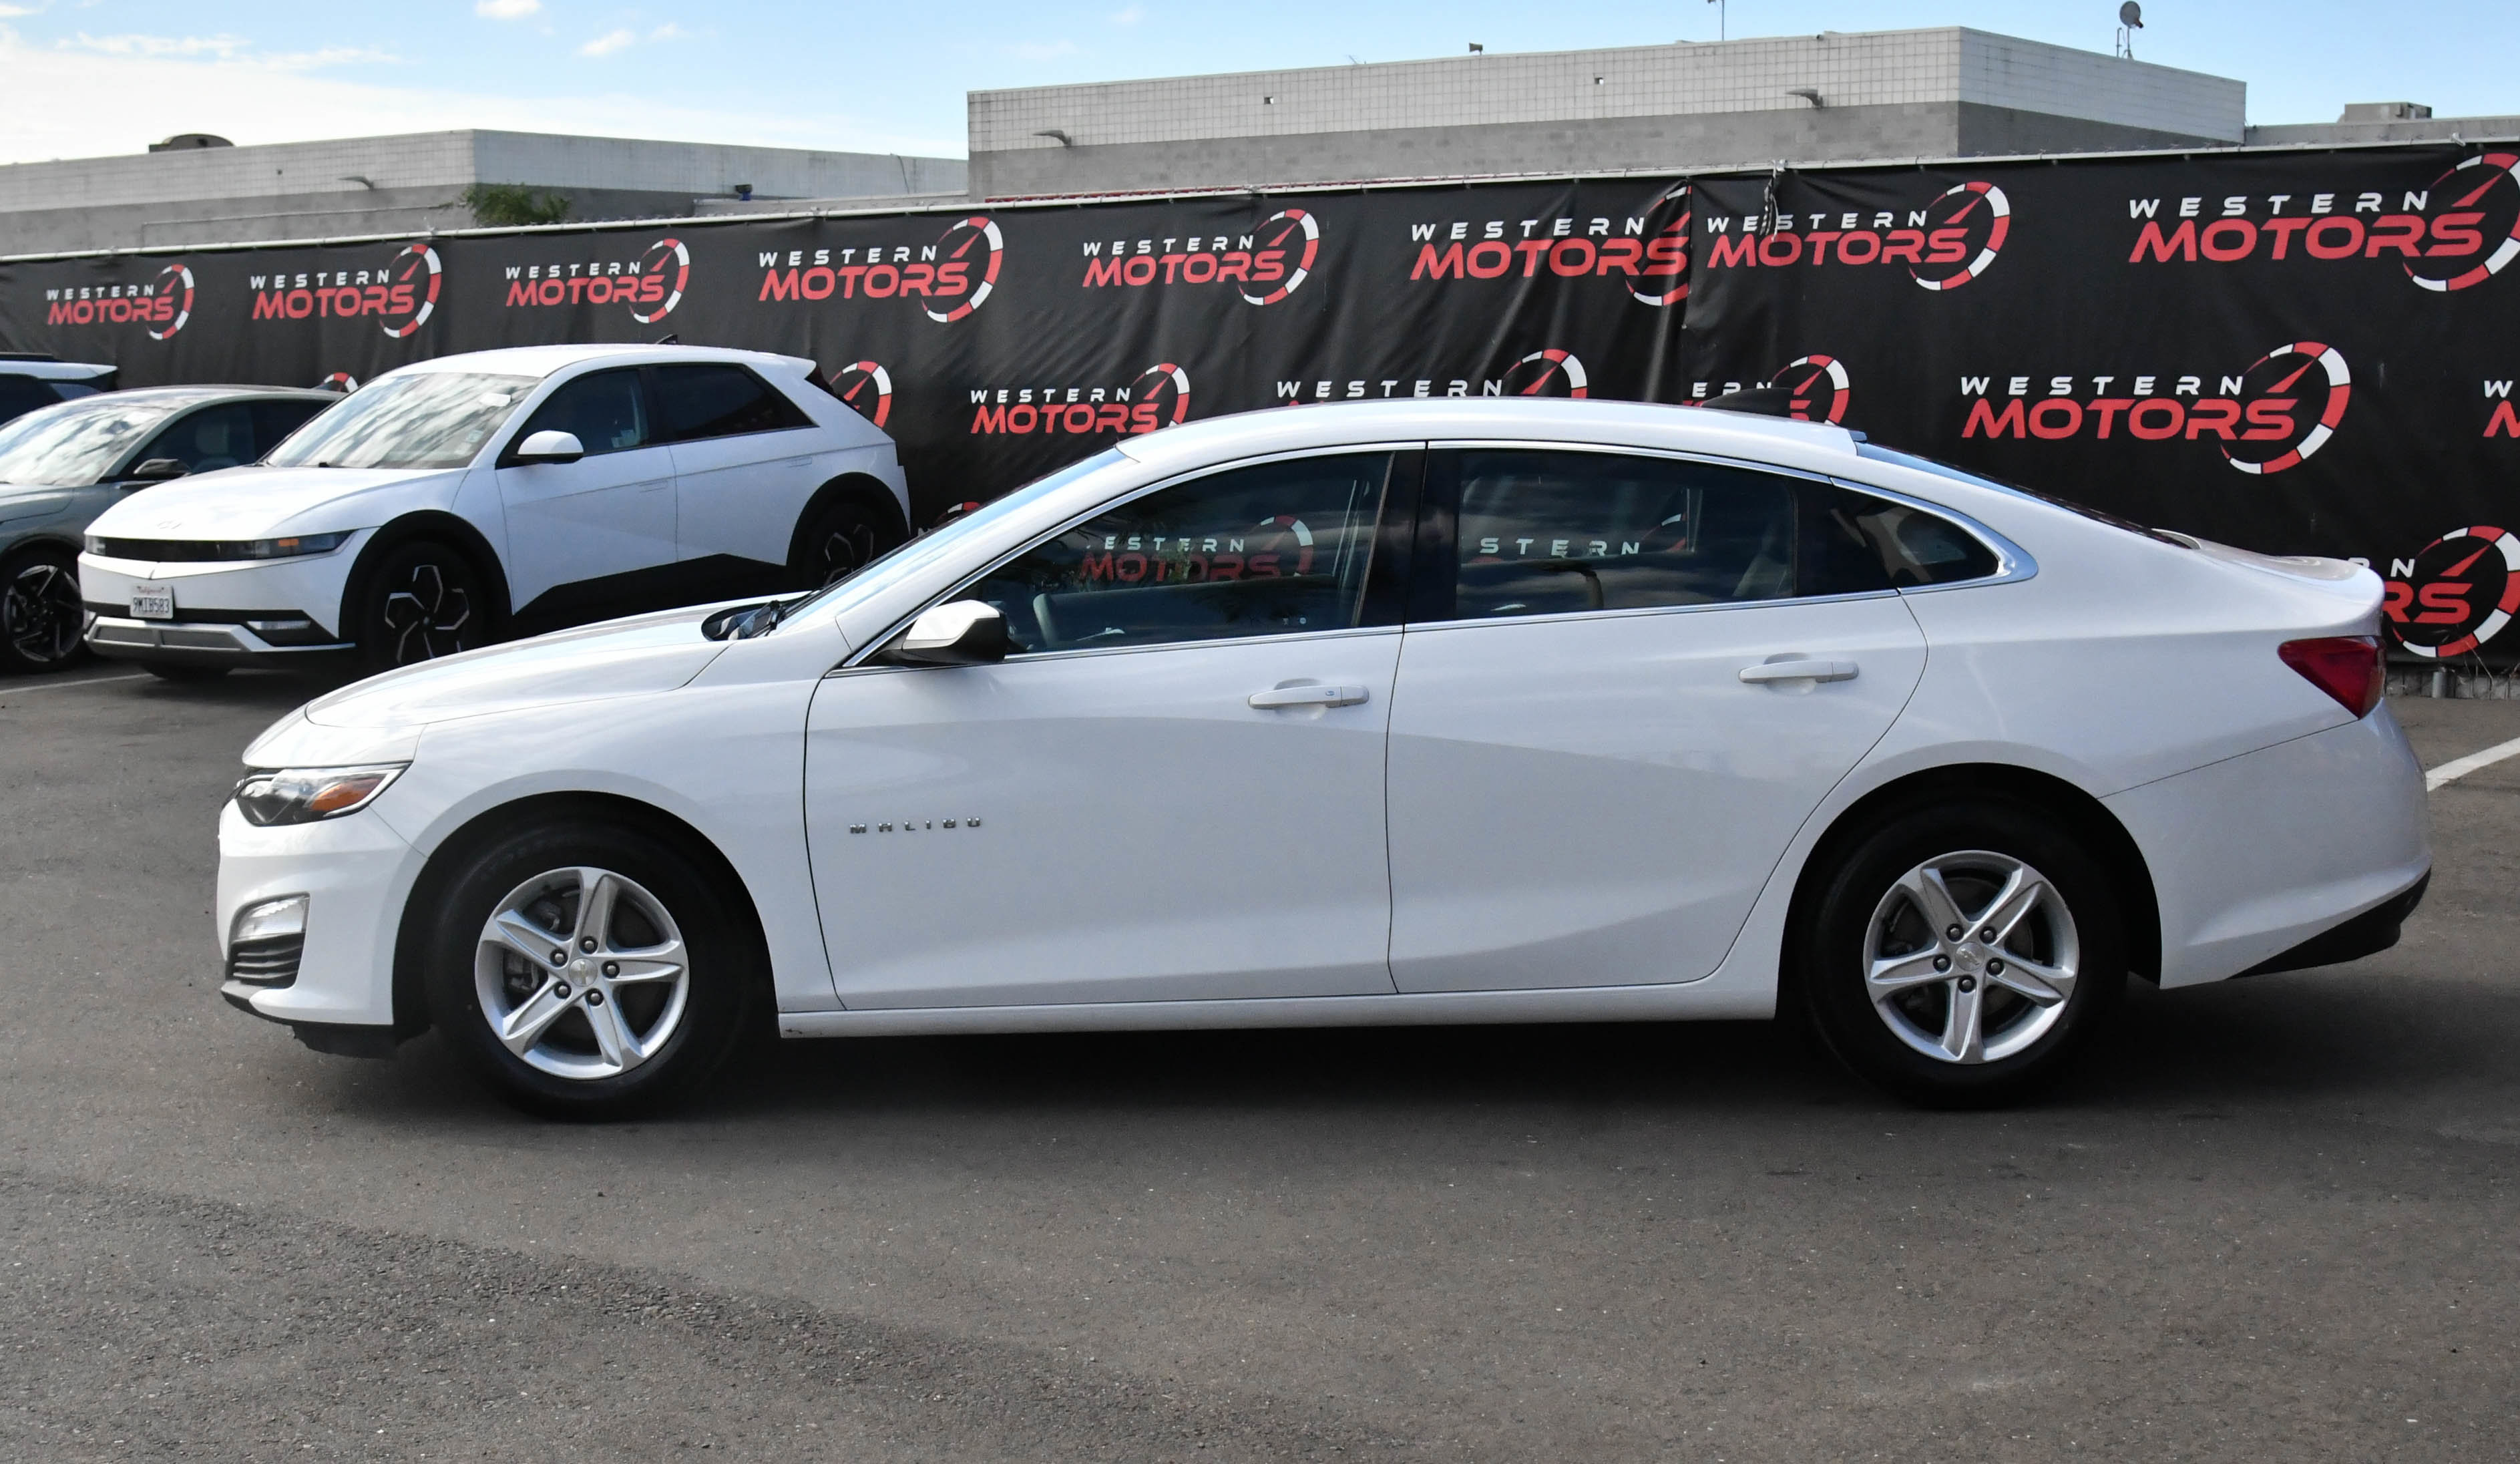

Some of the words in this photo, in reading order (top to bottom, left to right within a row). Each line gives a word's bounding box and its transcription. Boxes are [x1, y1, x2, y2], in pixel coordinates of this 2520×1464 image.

[2130, 192, 2427, 218] WESTERN
[1412, 218, 1644, 241] WESTERN
[1707, 210, 1926, 233] WESTERN
[1084, 235, 1253, 256] WESTERN
[1708, 230, 1968, 268] MOTORS
[2129, 213, 2485, 262] MOTORS
[760, 246, 936, 267] WESTERN
[1410, 236, 1689, 280] MOTORS
[251, 270, 389, 289] WESTERN
[506, 262, 640, 279] WESTERN
[1083, 250, 1285, 287] MOTORS
[47, 285, 154, 300] WESTERN
[507, 274, 664, 306] MOTORS
[759, 262, 969, 301] MOTORS
[48, 296, 173, 324] MOTORS
[253, 285, 414, 319] MOTORS
[971, 388, 1130, 403] WESTERN
[1277, 380, 1502, 398] WESTERN
[1962, 376, 2242, 395] WESTERN
[972, 403, 1159, 434] MOTORS
[1962, 399, 2297, 439] MOTORS
[1086, 536, 1245, 552] ESTERN
[1479, 538, 1640, 556] STERN
[850, 817, 980, 834] MALIBU
